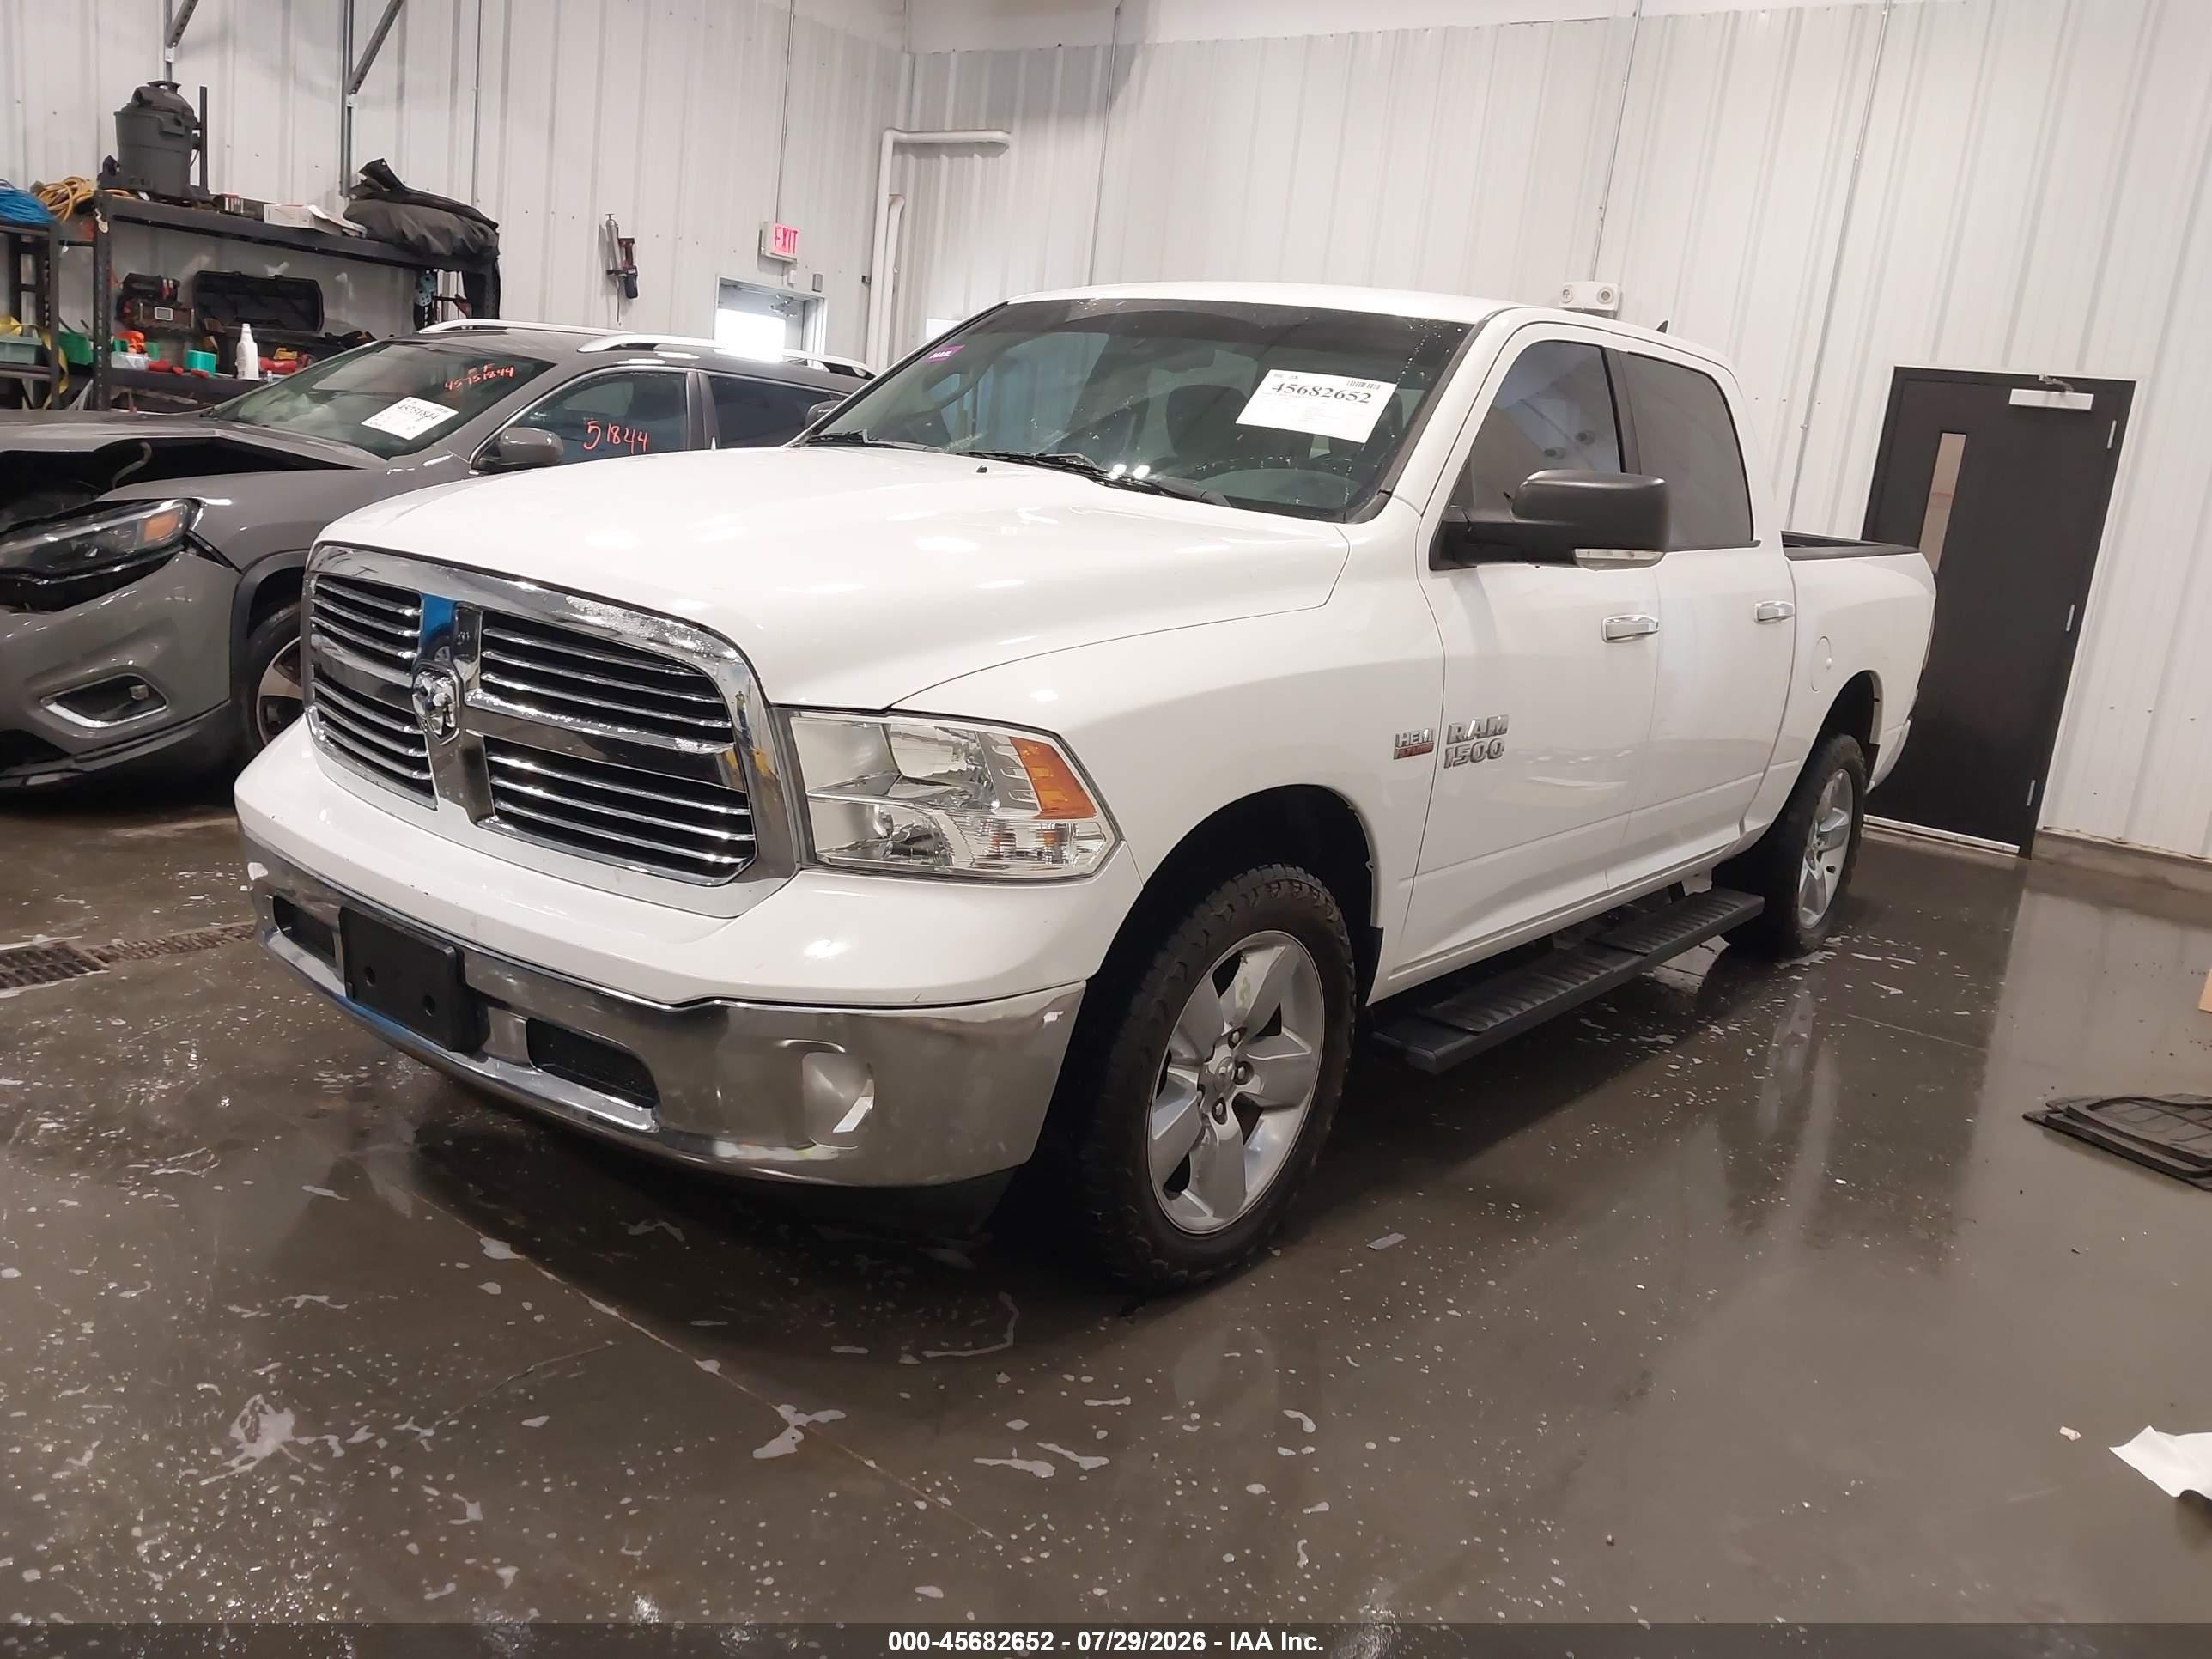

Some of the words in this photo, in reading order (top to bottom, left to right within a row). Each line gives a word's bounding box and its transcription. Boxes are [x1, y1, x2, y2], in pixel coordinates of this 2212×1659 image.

[775, 225, 799, 254] EXIT
[1271, 382, 1373, 404] 45682652
[583, 420, 649, 455] 51844
[1446, 714, 1509, 745] RAM
[1443, 738, 1505, 769] 1500
